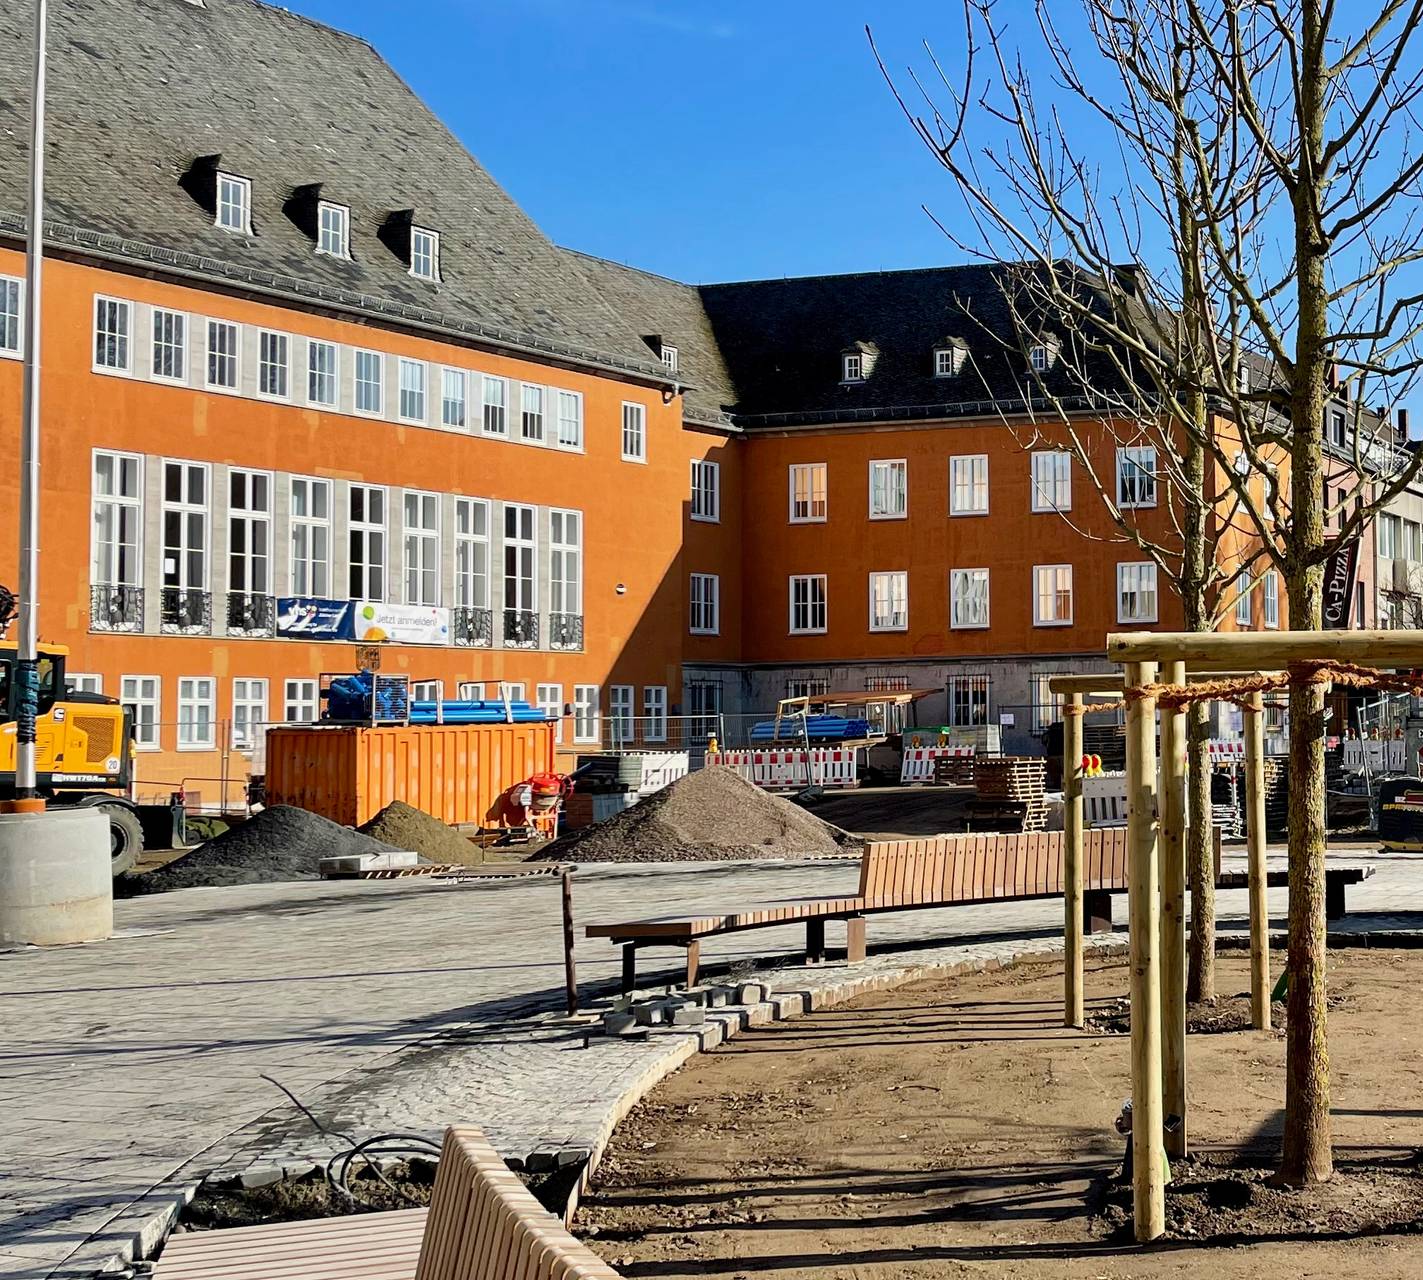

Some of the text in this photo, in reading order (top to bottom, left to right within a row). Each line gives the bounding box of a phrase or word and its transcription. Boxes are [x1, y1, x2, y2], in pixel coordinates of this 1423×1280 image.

[1325, 547, 1350, 622] CA-PIZZA
[377, 615, 438, 626] Jetzt anmelden!
[108, 760, 118, 770] 20
